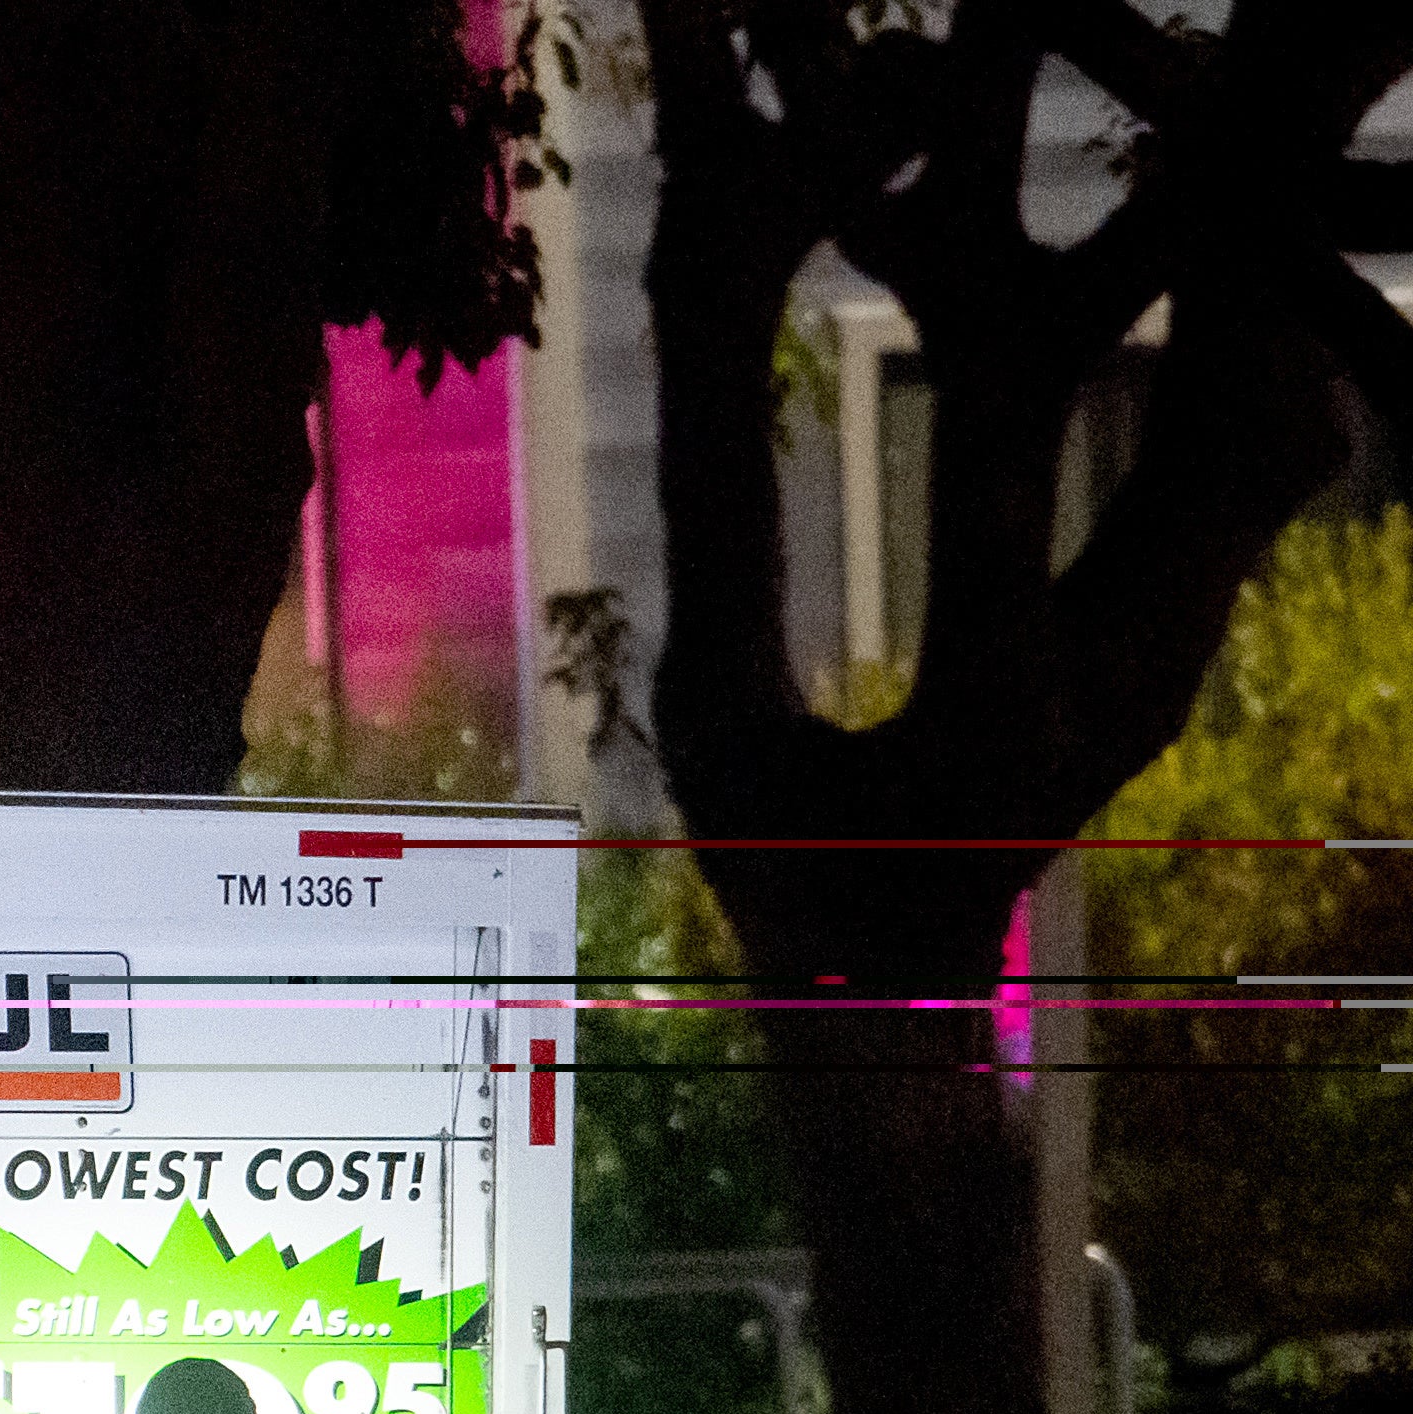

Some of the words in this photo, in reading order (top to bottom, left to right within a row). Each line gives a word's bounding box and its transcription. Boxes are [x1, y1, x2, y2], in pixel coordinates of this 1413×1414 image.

[217, 874, 266, 906] TM
[281, 876, 353, 907] 1336
[363, 877, 383, 907] T
[244, 1148, 426, 1201] COST!
[12, 1294, 99, 1337] Still
[109, 1300, 168, 1337] As
[182, 1300, 279, 1337] Low
[289, 1300, 392, 1337] As...
